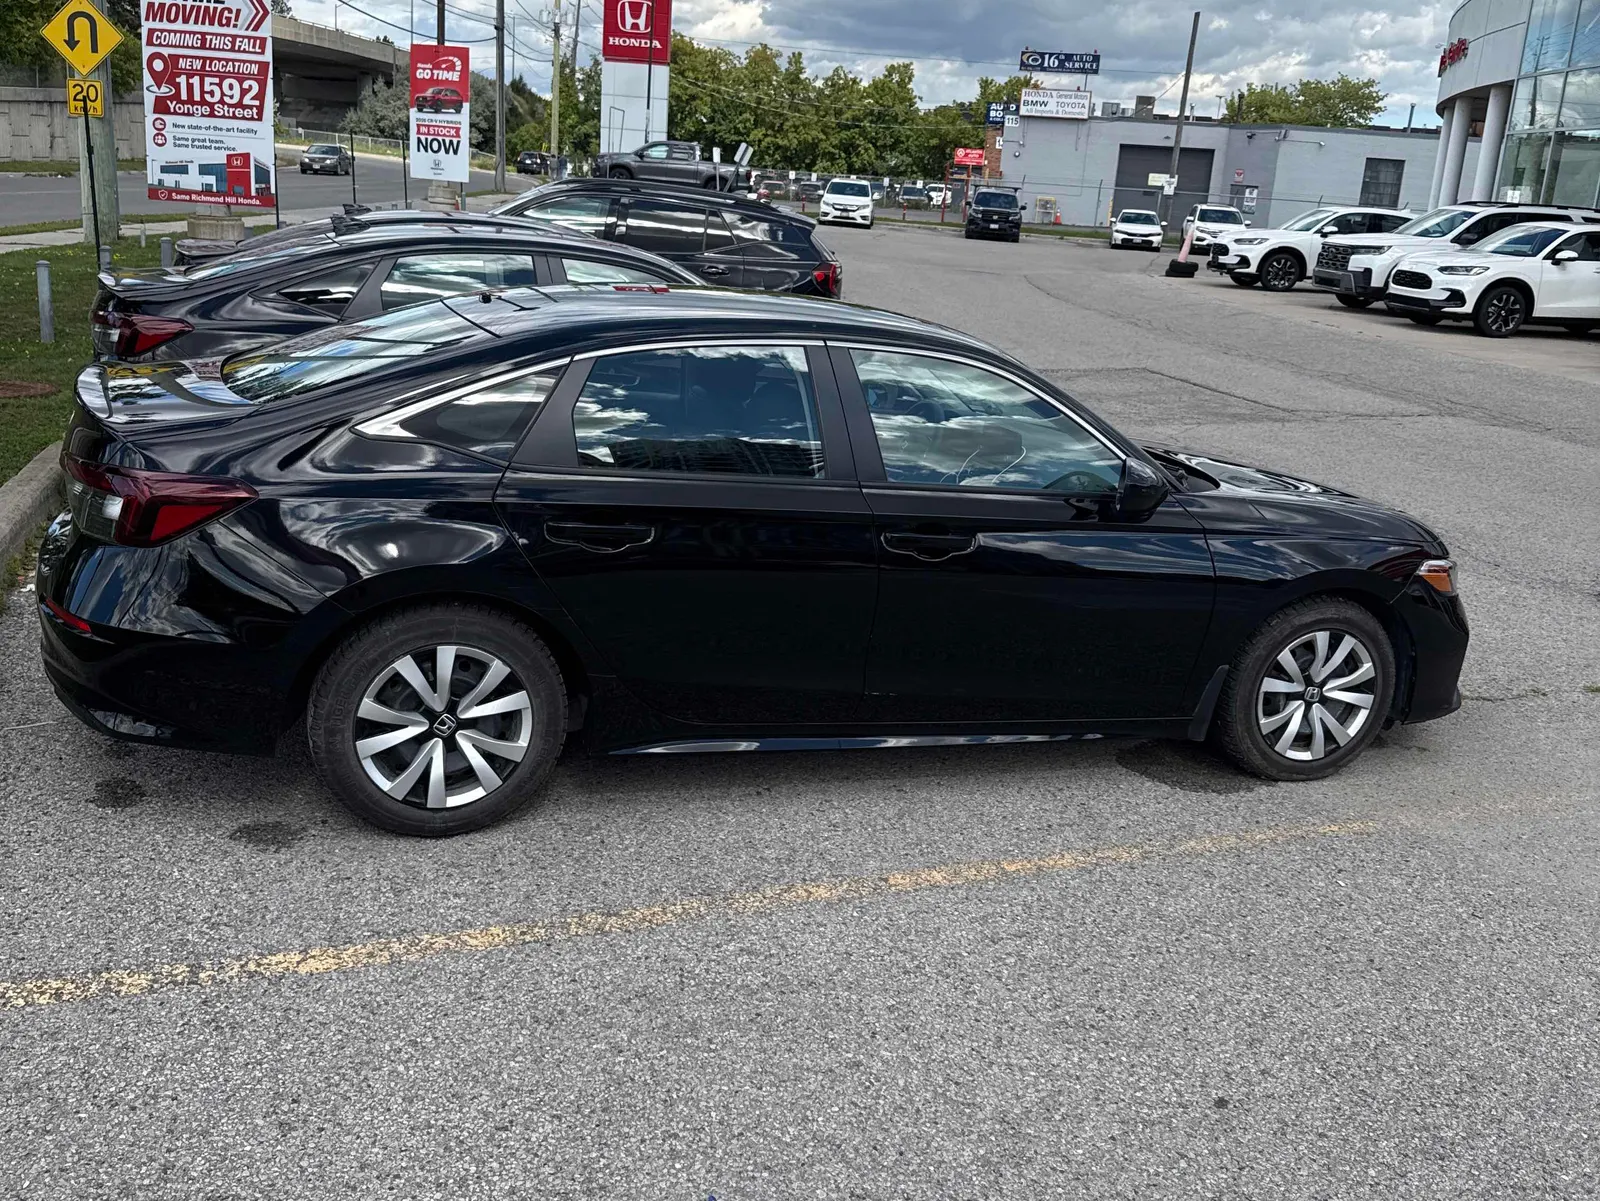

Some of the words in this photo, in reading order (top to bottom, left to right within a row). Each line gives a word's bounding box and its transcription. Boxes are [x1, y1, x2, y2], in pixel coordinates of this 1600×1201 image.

[144, 2, 242, 28] MOVING!
[152, 31, 202, 48] COMING
[205, 35, 232, 50] THIS
[234, 37, 262, 53] FALL
[608, 36, 663, 49] HONDA
[178, 57, 202, 70] NEW
[205, 60, 259, 74] LOCATION
[1064, 61, 1098, 70] SERVICE
[415, 69, 432, 80] GO
[433, 70, 461, 82] TIME
[72, 83, 99, 103] 20
[175, 74, 260, 106] 11592
[1024, 90, 1054, 99] HONDA
[1056, 92, 1073, 100] General
[166, 100, 211, 117] Yonge
[213, 103, 259, 119] Street
[1022, 99, 1049, 108] BMW
[1055, 101, 1086, 109] TOYOTA
[1034, 108, 1054, 116] Imports
[1007, 116, 1019, 126] 115
[172, 122, 186, 130] New
[187, 123, 235, 134] state-of-the-art
[236, 126, 258, 136] facility
[419, 126, 429, 134] IN
[429, 126, 457, 136] STOCK
[172, 135, 190, 143] Same
[190, 137, 208, 146] great
[172, 141, 190, 149] Same
[190, 141, 213, 150] trusted
[213, 144, 238, 153] service.
[416, 136, 461, 156] NOW
[171, 192, 190, 201] Same
[191, 194, 224, 204] Richmond
[225, 196, 237, 204] Hill
[238, 198, 262, 206] Honda.
